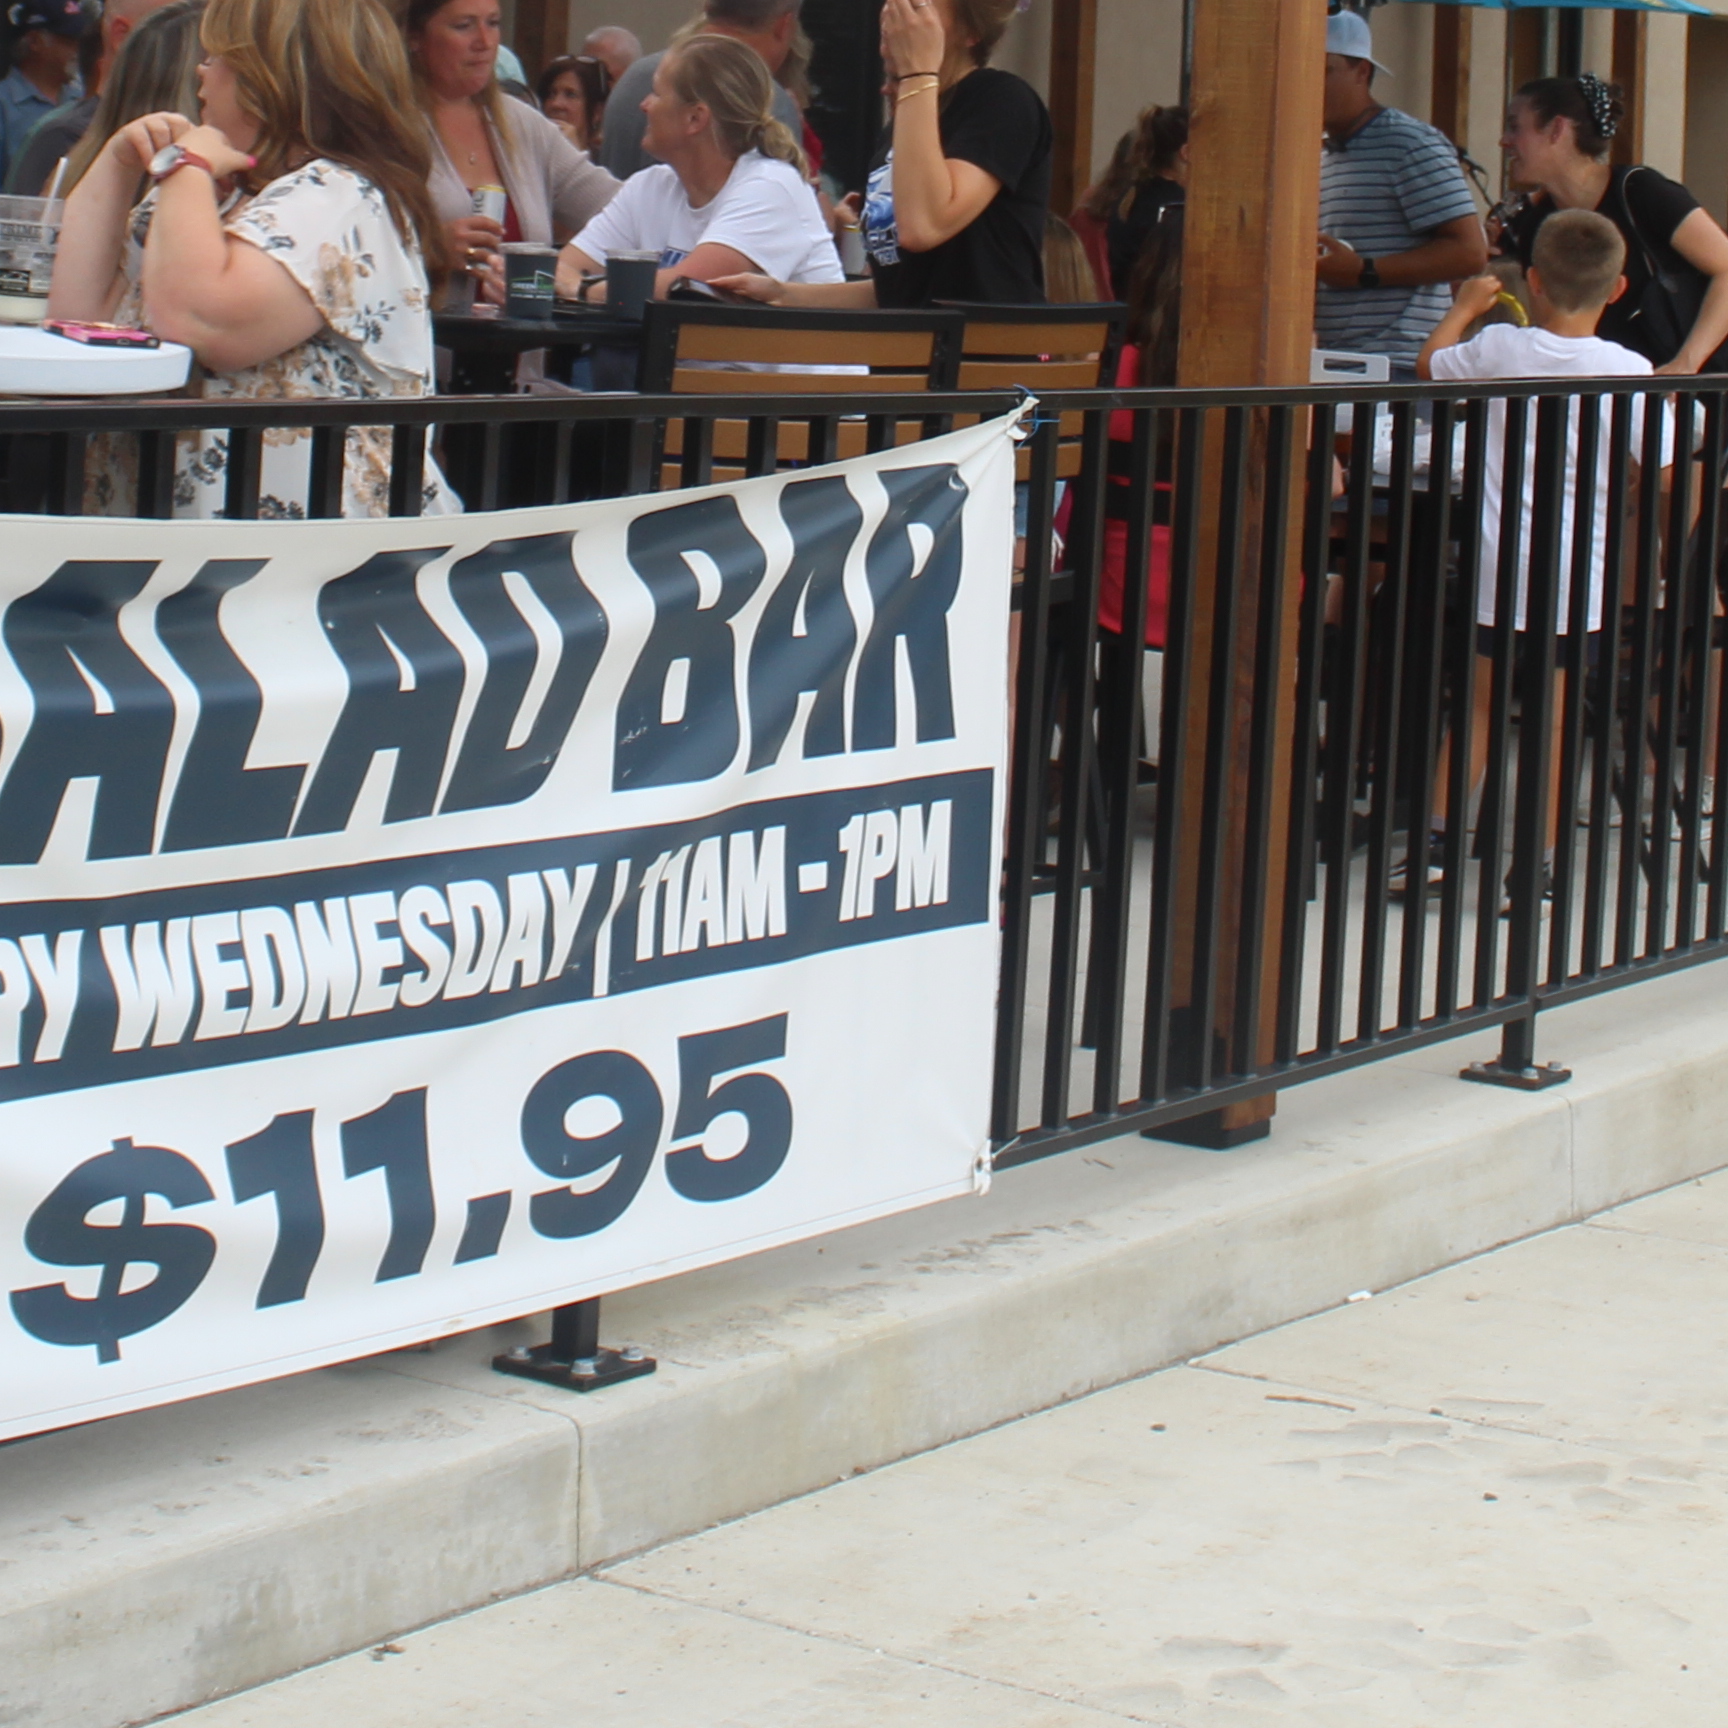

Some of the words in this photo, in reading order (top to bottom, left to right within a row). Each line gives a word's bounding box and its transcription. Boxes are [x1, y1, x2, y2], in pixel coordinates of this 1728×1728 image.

[613, 462, 970, 794] BAR
[96, 864, 596, 1052] WEDNESDAY
[636, 825, 787, 962] 11AM
[838, 800, 952, 922] 1PM
[9, 1012, 795, 1363] $11.95
